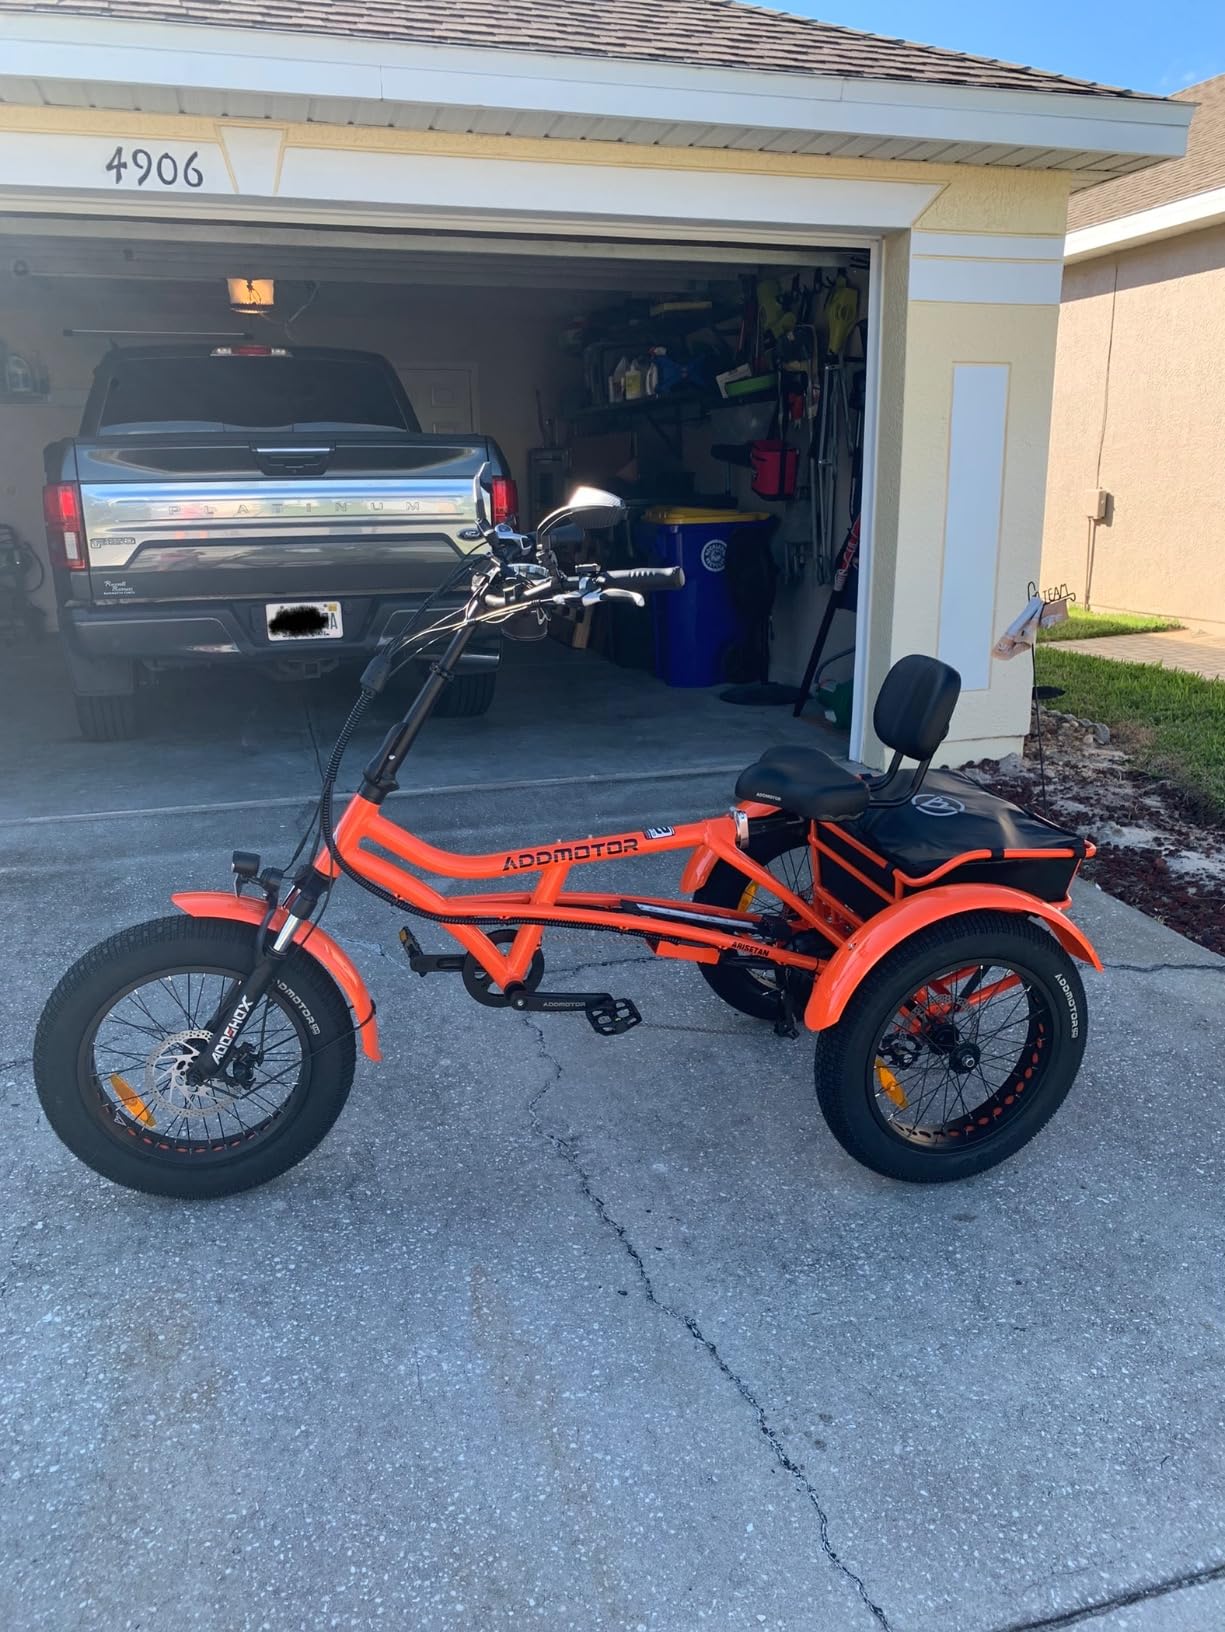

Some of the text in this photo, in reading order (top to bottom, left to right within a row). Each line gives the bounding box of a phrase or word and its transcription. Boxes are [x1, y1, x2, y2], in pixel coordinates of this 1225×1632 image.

[105, 146, 203, 187] 4906
[168, 502, 421, 516] PLATINUM
[1043, 583, 1069, 603] TEAM
[502, 838, 639, 871] ADDMOTOR
[731, 941, 770, 957] ARISETAN
[1054, 973, 1079, 1028] ADDMOTOR
[211, 994, 254, 1066] ADDSHOX
